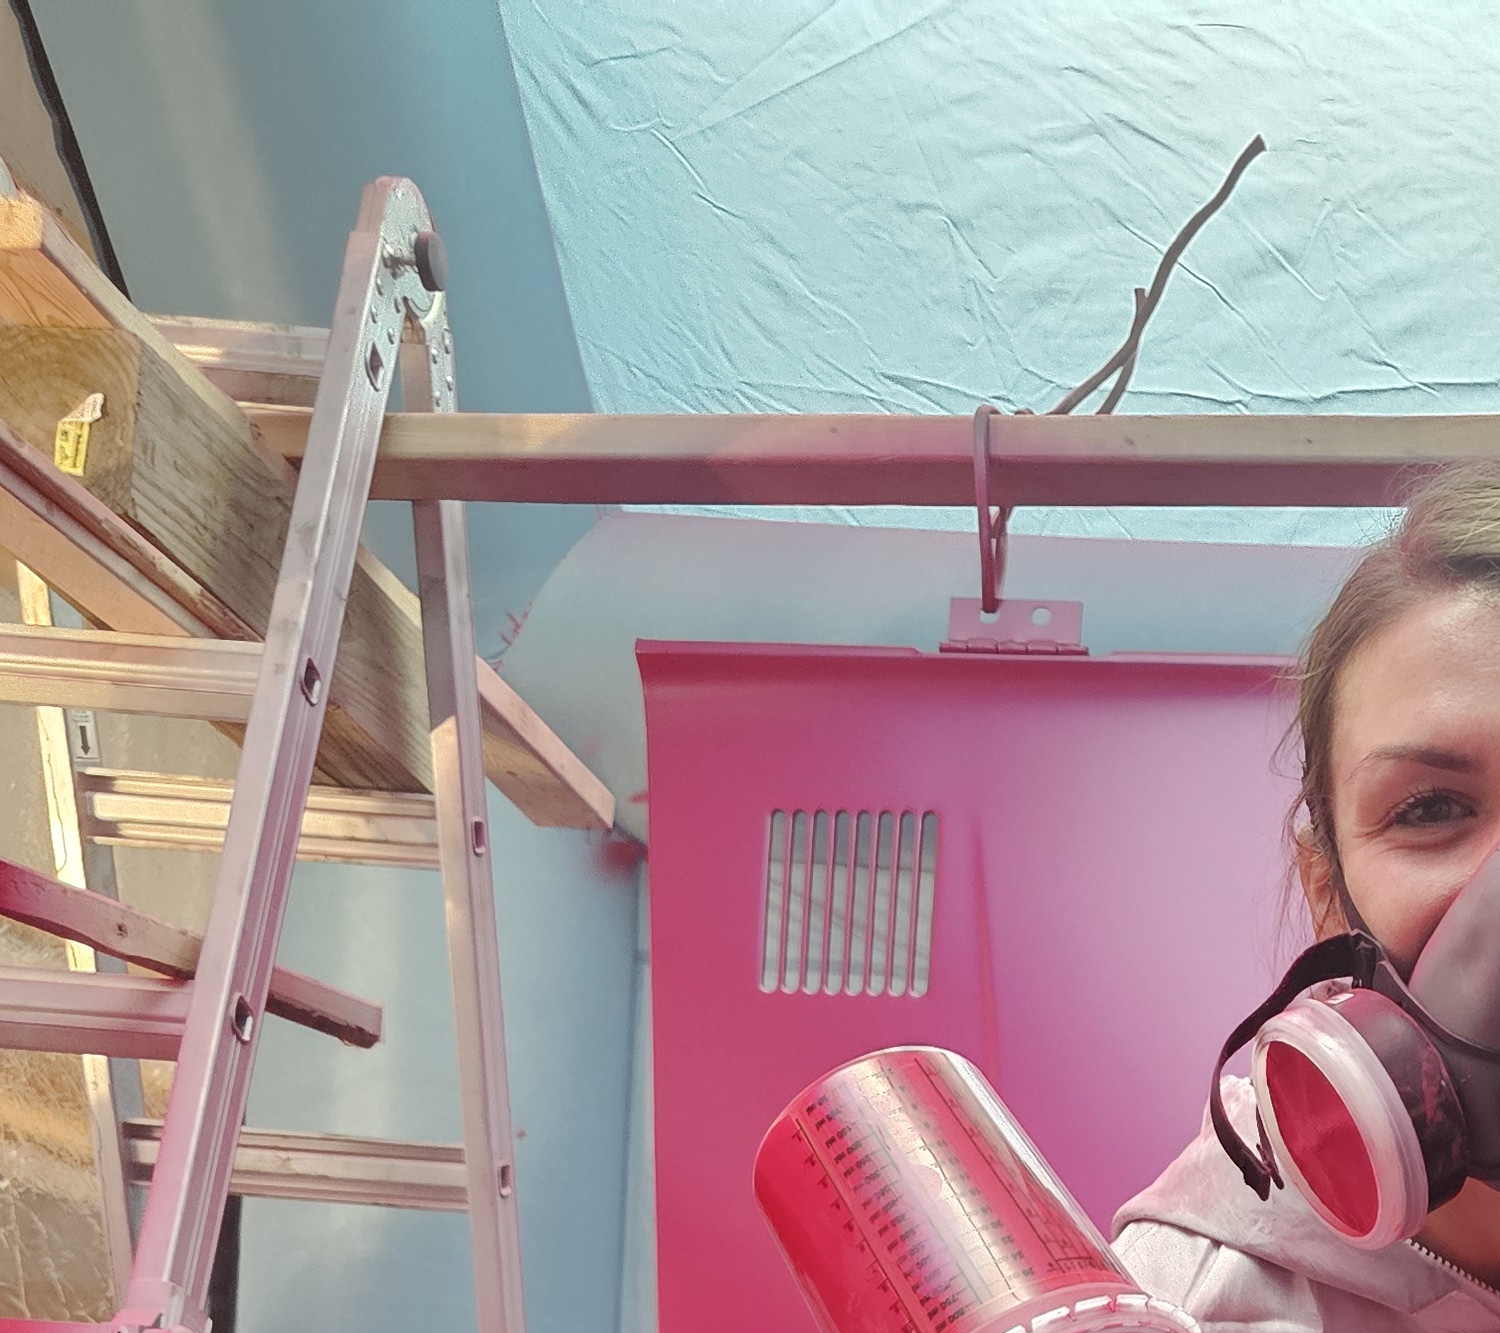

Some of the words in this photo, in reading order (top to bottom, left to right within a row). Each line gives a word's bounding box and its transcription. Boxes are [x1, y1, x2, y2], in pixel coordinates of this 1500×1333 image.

[805, 1103, 816, 1115] ml
[814, 1118, 825, 1131] ml
[836, 1125, 851, 1140] 150
[825, 1135, 836, 1148] ml
[845, 1140, 861, 1154] 200
[834, 1151, 845, 1163] ml
[854, 1154, 870, 1169] 250
[843, 1166, 854, 1179] ml
[862, 1197, 873, 1209] ml
[869, 1211, 880, 1224] ml
[878, 1224, 889, 1237] ml
[899, 1228, 915, 1241] 500
[886, 1239, 898, 1252] ml
[919, 1293, 931, 1306] ml
[939, 1294, 957, 1310] 750
[927, 1306, 938, 1320] ml
[947, 1308, 964, 1323] 800
[933, 1320, 946, 1333] ml
